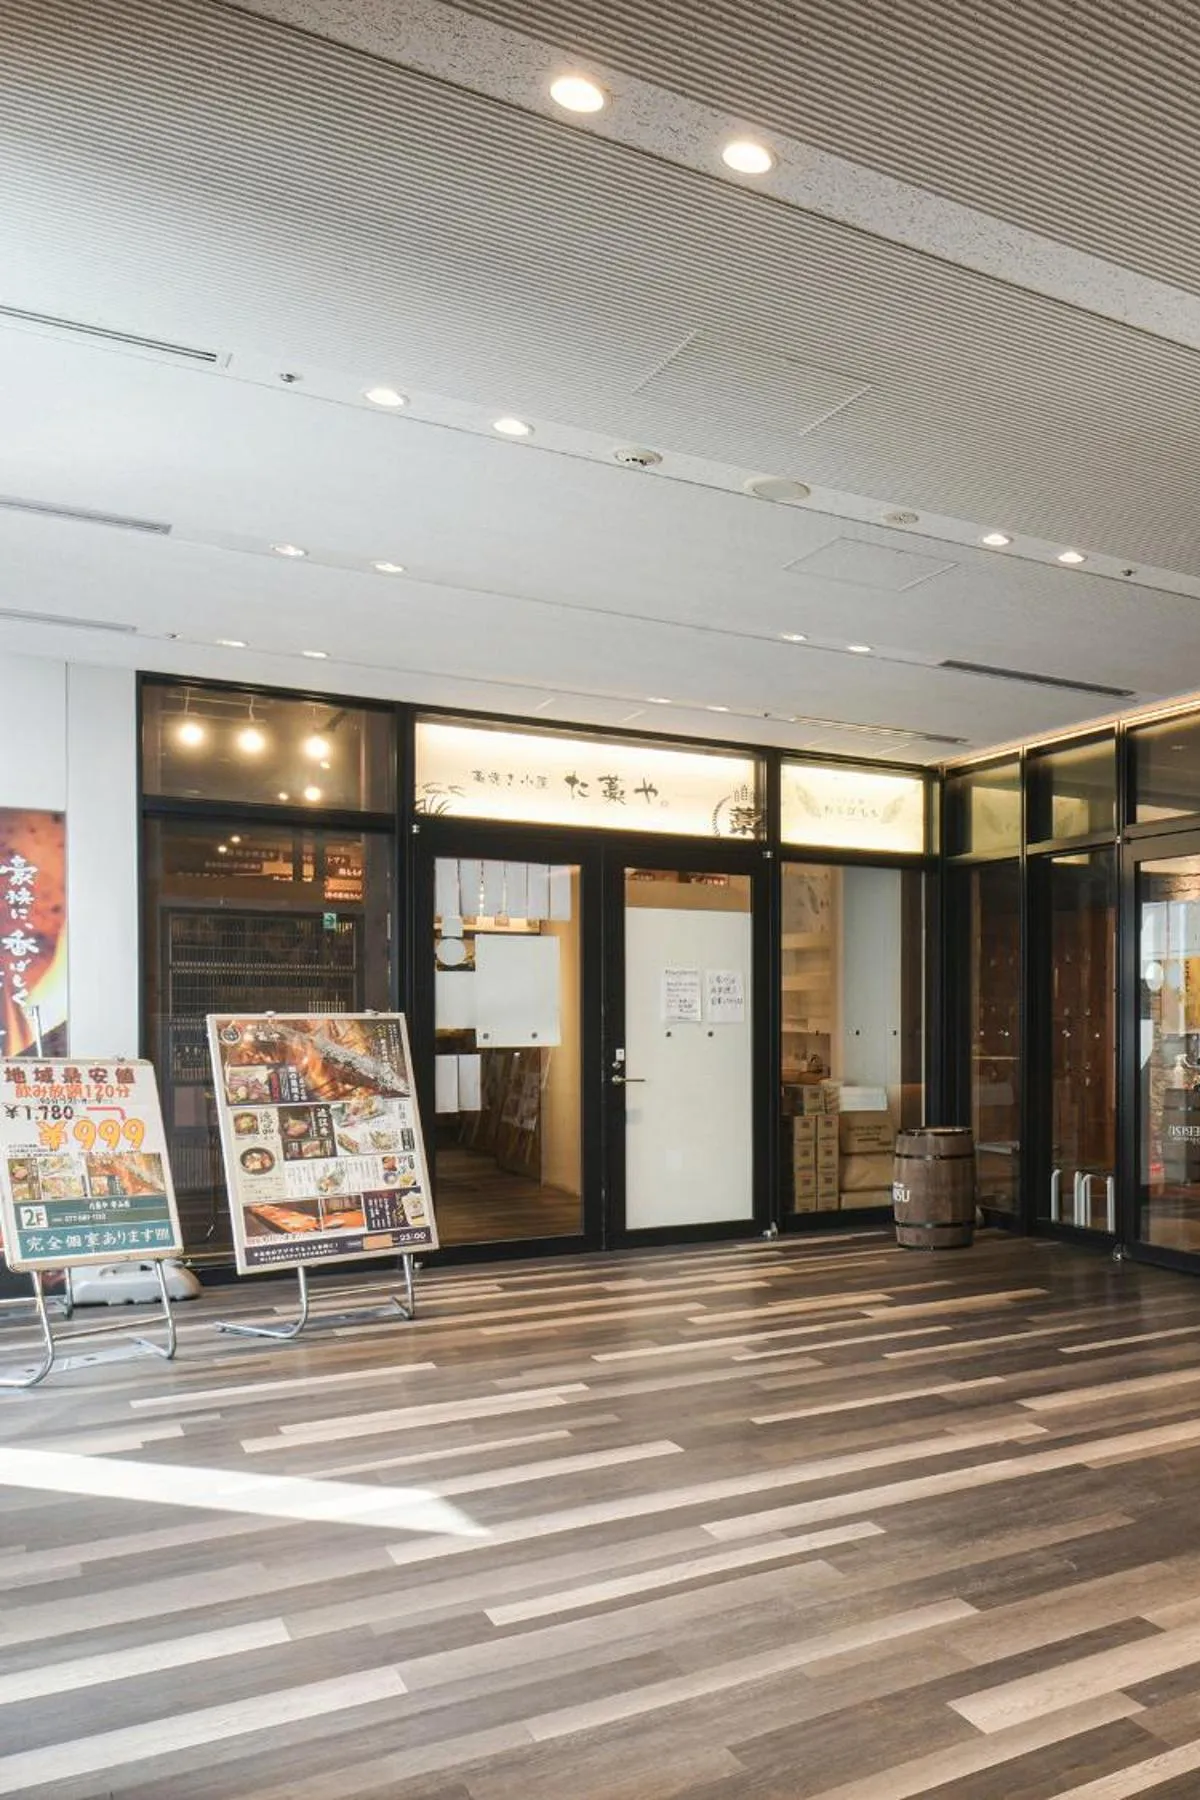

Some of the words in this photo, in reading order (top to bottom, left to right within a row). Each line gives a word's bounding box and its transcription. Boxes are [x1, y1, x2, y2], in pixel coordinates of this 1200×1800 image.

[4, 1067, 135, 1084] 地域最安値
[36, 1118, 145, 1152] ¥999
[24, 1208, 44, 1227] 2F
